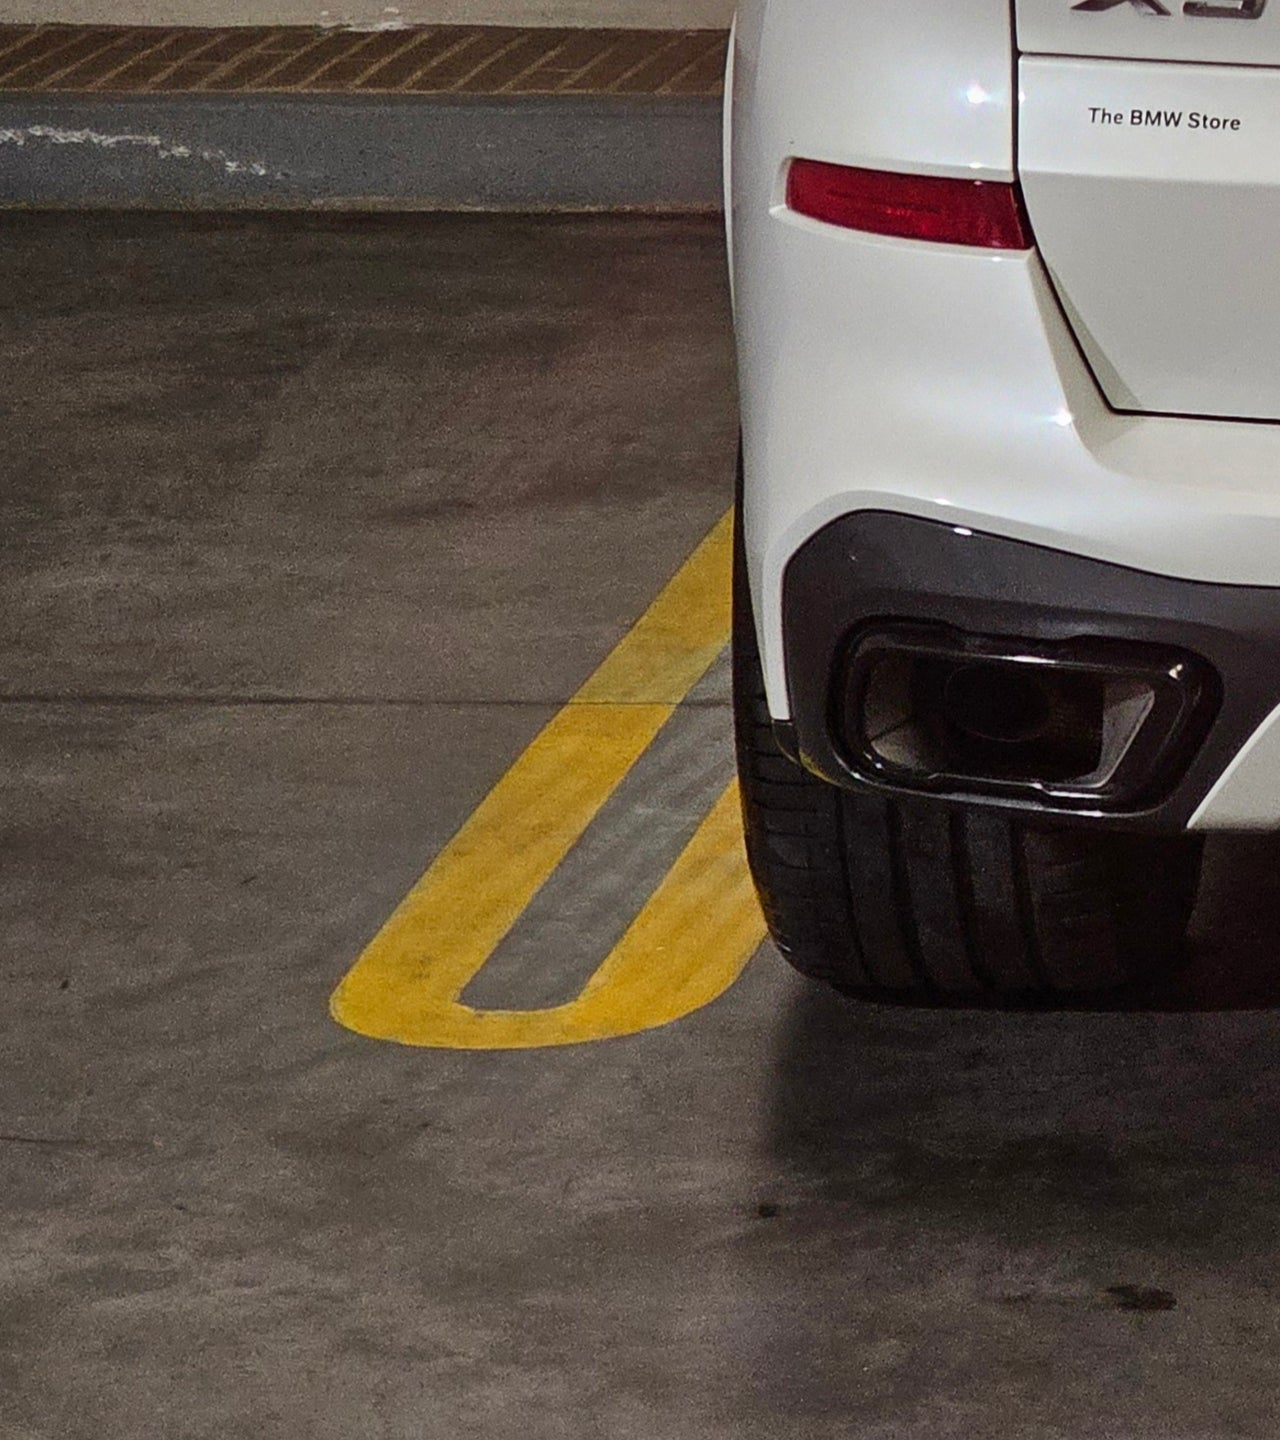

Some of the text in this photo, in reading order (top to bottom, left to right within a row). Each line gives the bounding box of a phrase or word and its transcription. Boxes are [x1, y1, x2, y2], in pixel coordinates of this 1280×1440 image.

[1088, 107, 1241, 131] The BMW Store
